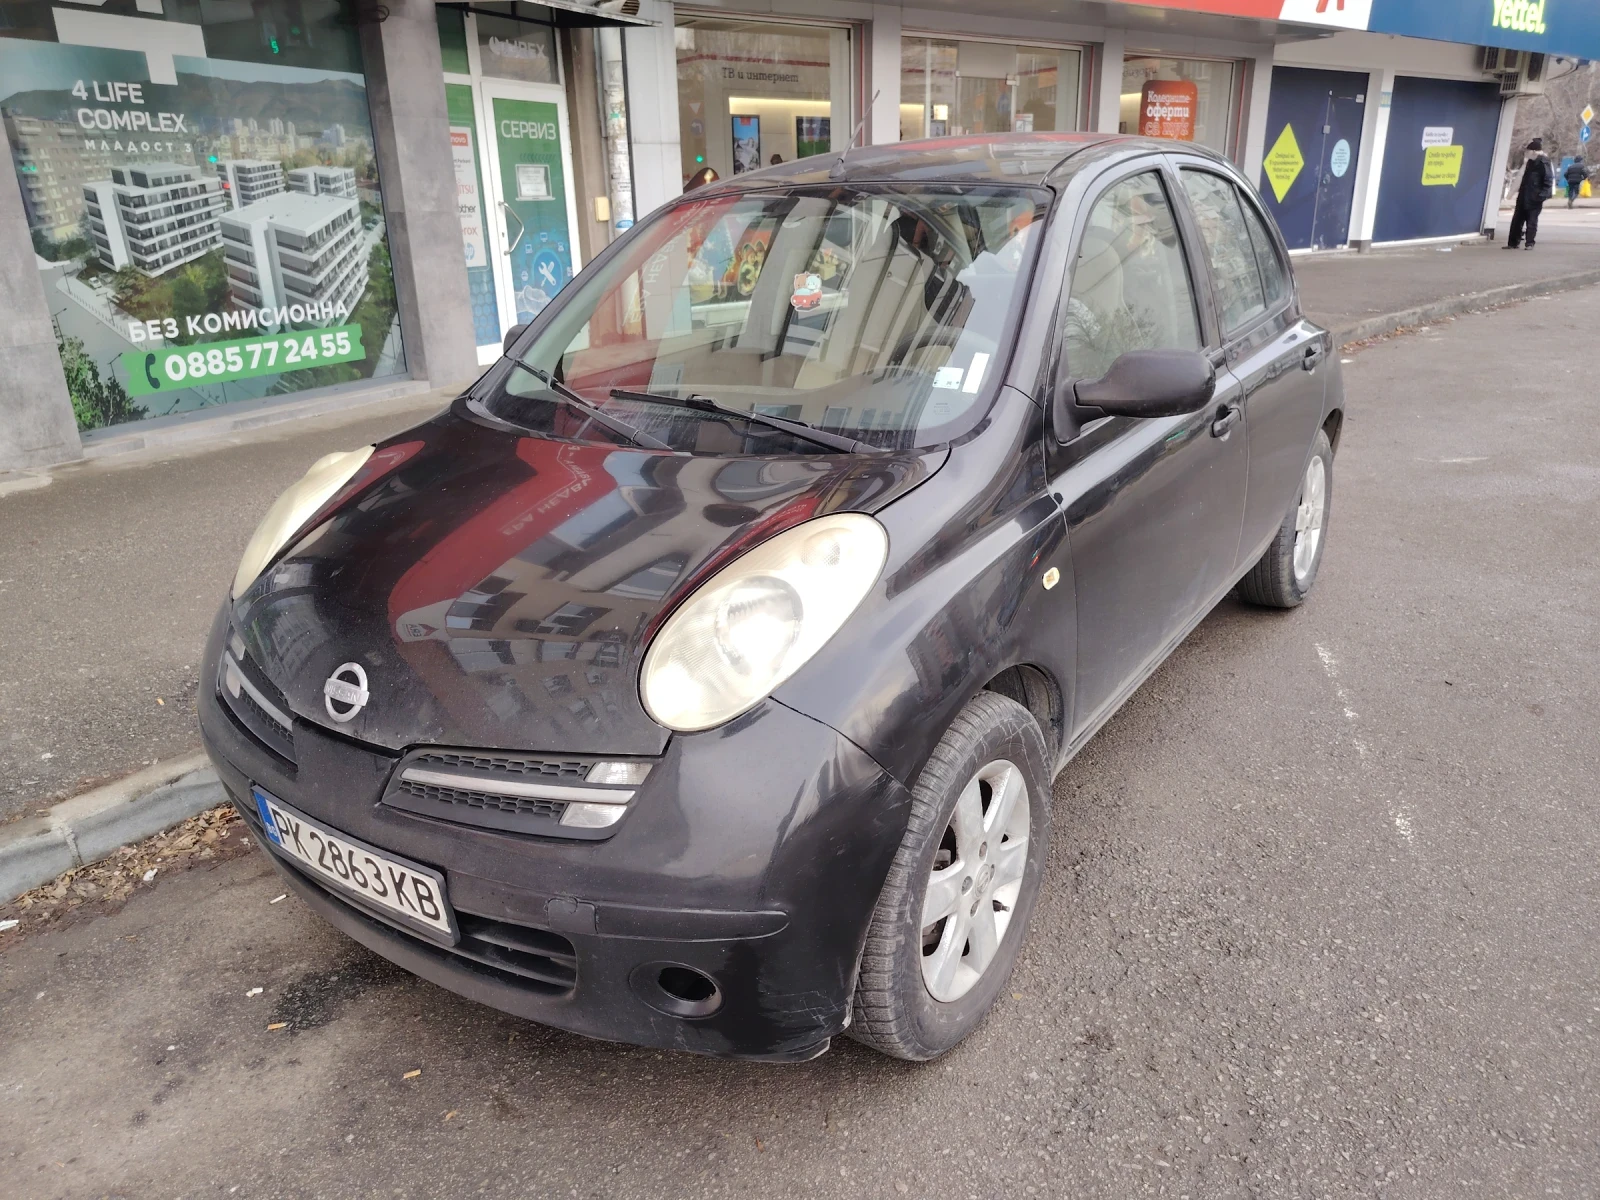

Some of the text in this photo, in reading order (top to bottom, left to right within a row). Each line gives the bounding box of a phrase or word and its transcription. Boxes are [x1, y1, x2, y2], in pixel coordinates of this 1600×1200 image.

[722, 67, 799, 84] ТВ и интернет
[72, 80, 145, 104] 4 LIFE
[77, 108, 188, 133] COMPLEX
[1146, 103, 1190, 121] оферти
[501, 120, 557, 140] СЕРВИЗ
[84, 140, 192, 153] МЛАДОСТ 3
[451, 136, 467, 144] novo
[459, 203, 476, 214] other
[128, 300, 349, 343] БЕЗ КОМИСИОННА
[165, 332, 351, 381] 0885 77 24 55
